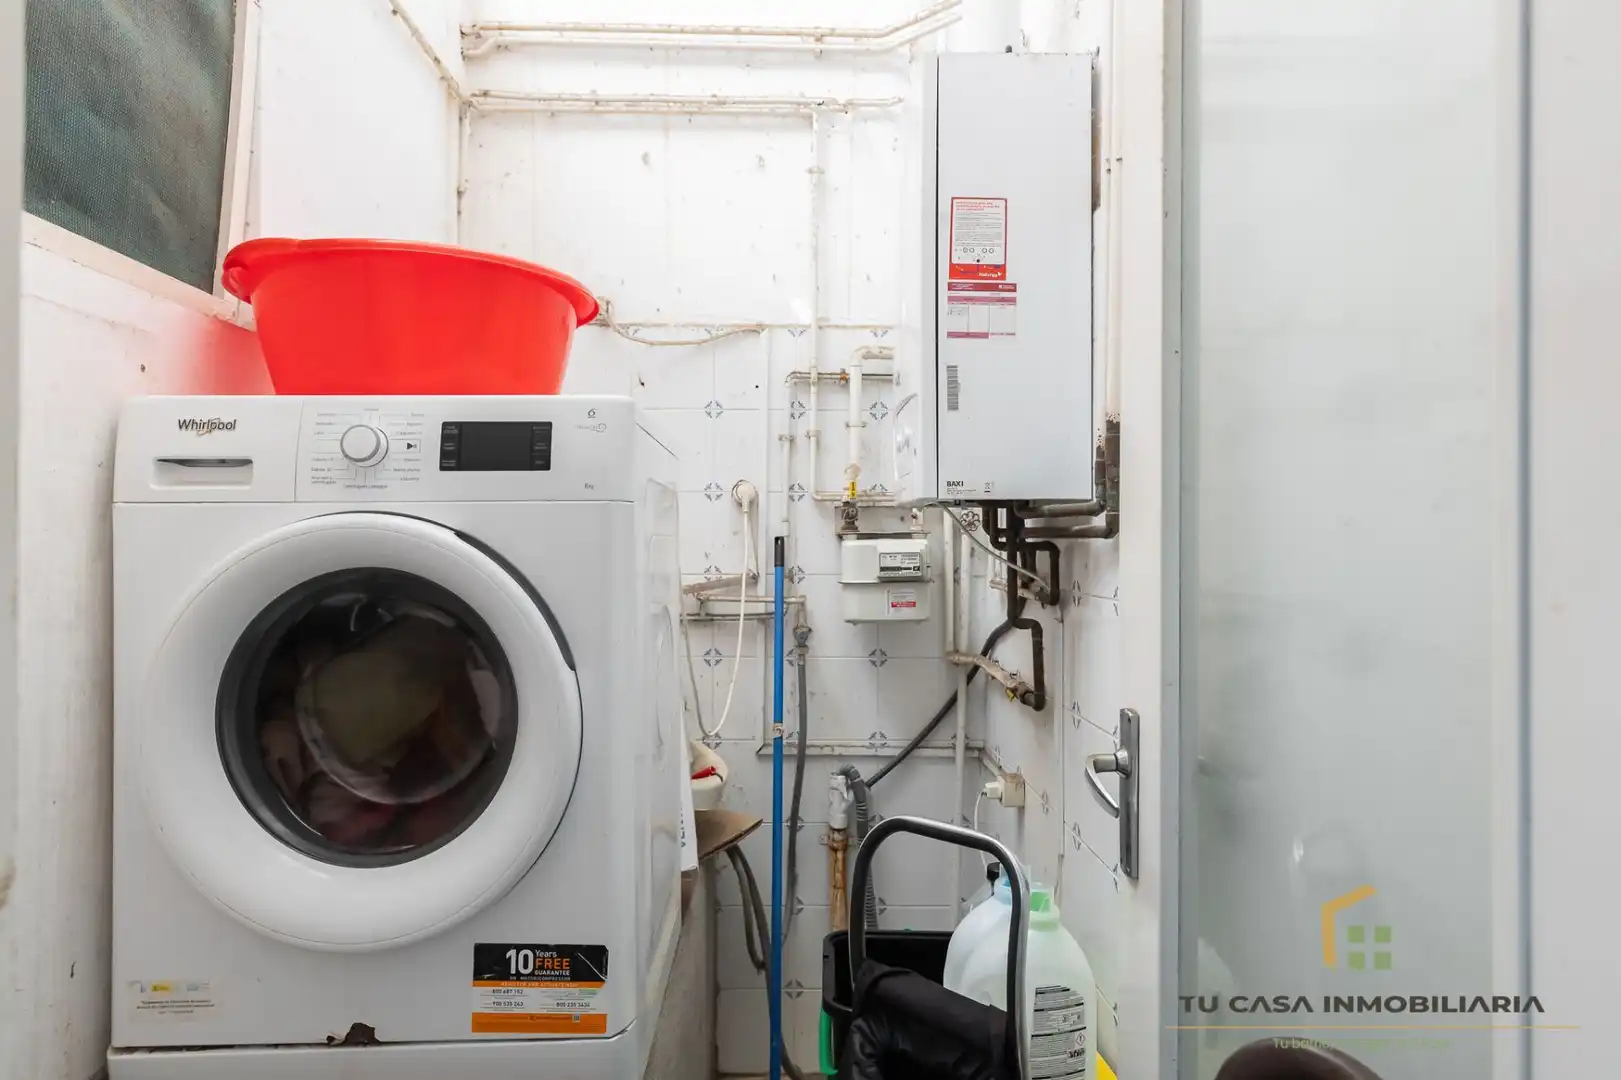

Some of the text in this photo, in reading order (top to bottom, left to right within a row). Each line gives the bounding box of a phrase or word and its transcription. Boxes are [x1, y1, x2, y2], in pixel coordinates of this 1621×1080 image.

[178, 417, 237, 434] Whirlpool
[535, 949, 557, 958] Years
[506, 949, 534, 975] 10
[535, 958, 570, 970] FREE
